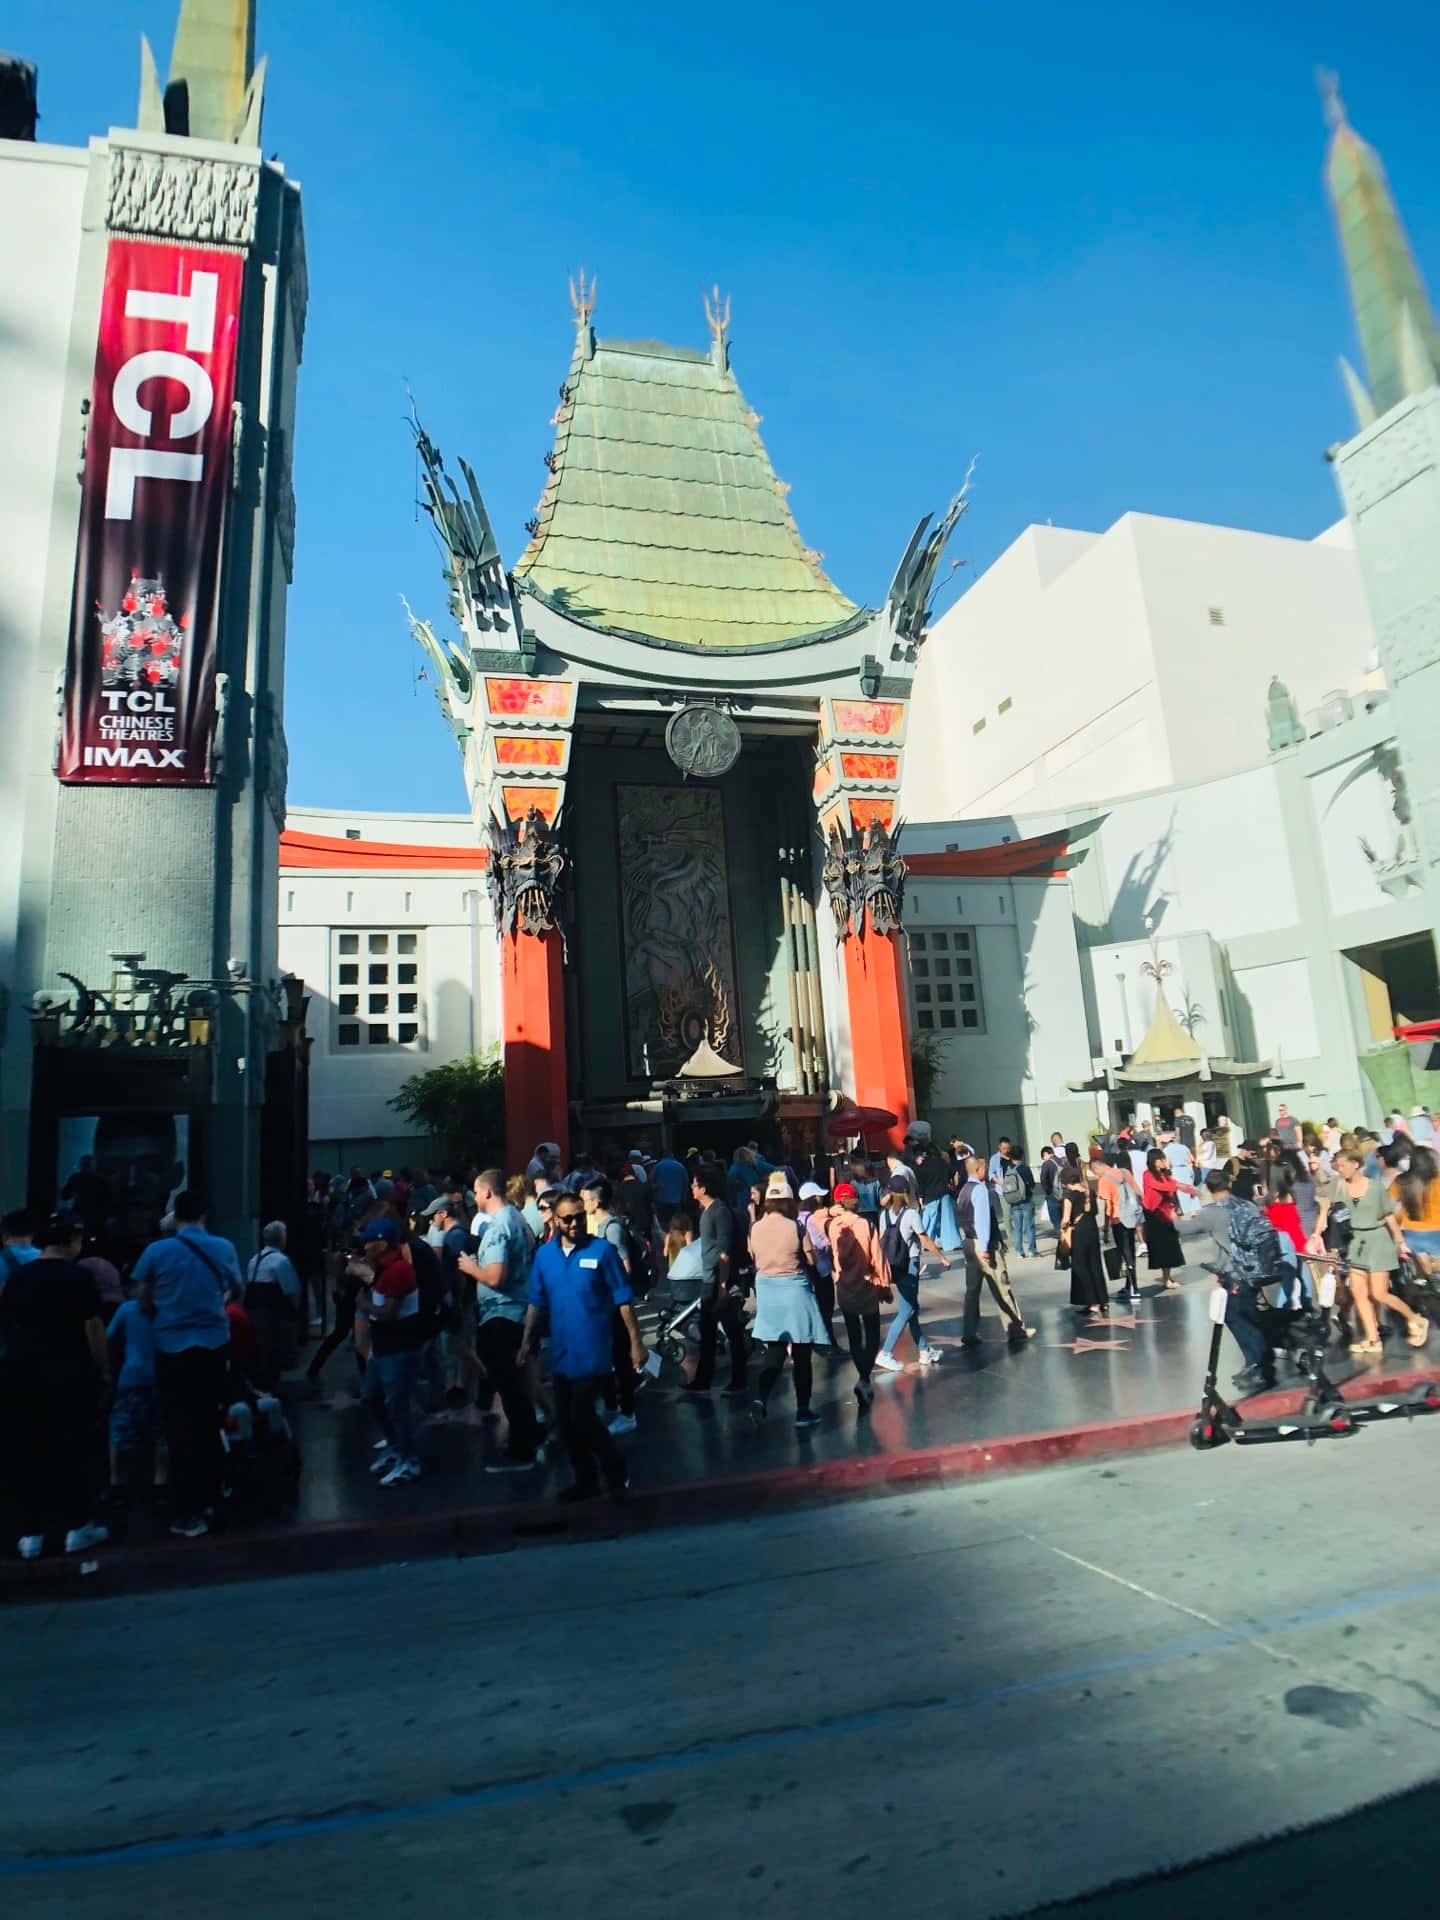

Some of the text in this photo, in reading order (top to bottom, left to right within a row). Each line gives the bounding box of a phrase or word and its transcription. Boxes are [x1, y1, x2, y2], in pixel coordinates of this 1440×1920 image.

[104, 270, 218, 520] TCL
[101, 690, 176, 713] TCL
[99, 715, 175, 730] CHINESE
[99, 728, 175, 742] THEATRES
[83, 746, 187, 768] IMAX
